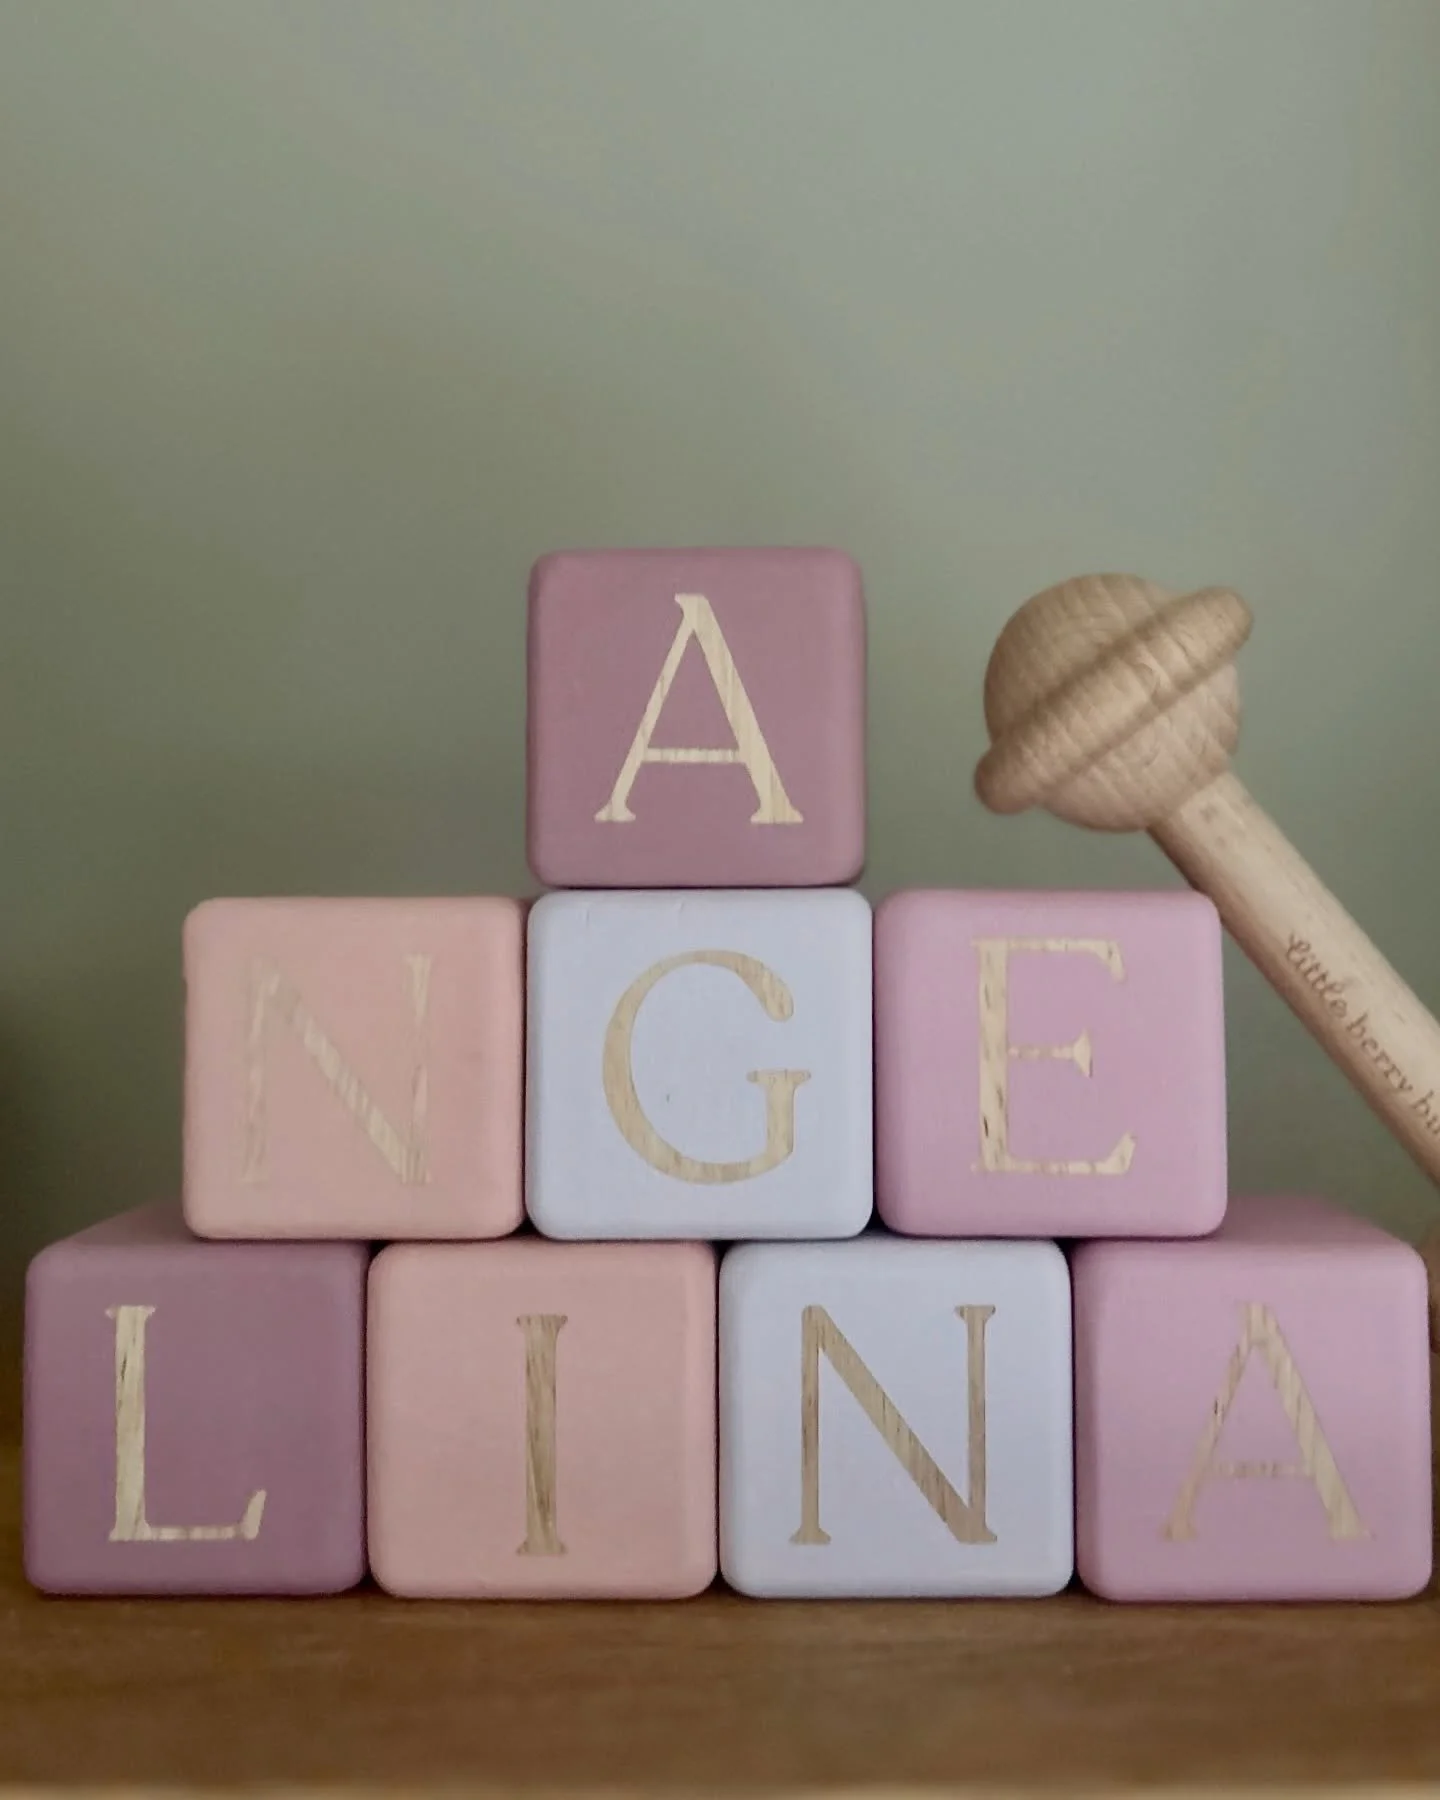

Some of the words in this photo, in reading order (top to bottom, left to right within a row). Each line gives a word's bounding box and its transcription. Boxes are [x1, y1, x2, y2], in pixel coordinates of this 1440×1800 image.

[594, 592, 804, 824] A
[243, 954, 432, 1186] N
[602, 949, 812, 1184] G
[972, 938, 1137, 1177] E
[1347, 1013, 1413, 1092] berry
[104, 1303, 267, 1544] L
[514, 1314, 569, 1559] I
[789, 1303, 998, 1546] N
[1164, 1302, 1373, 1542] A
